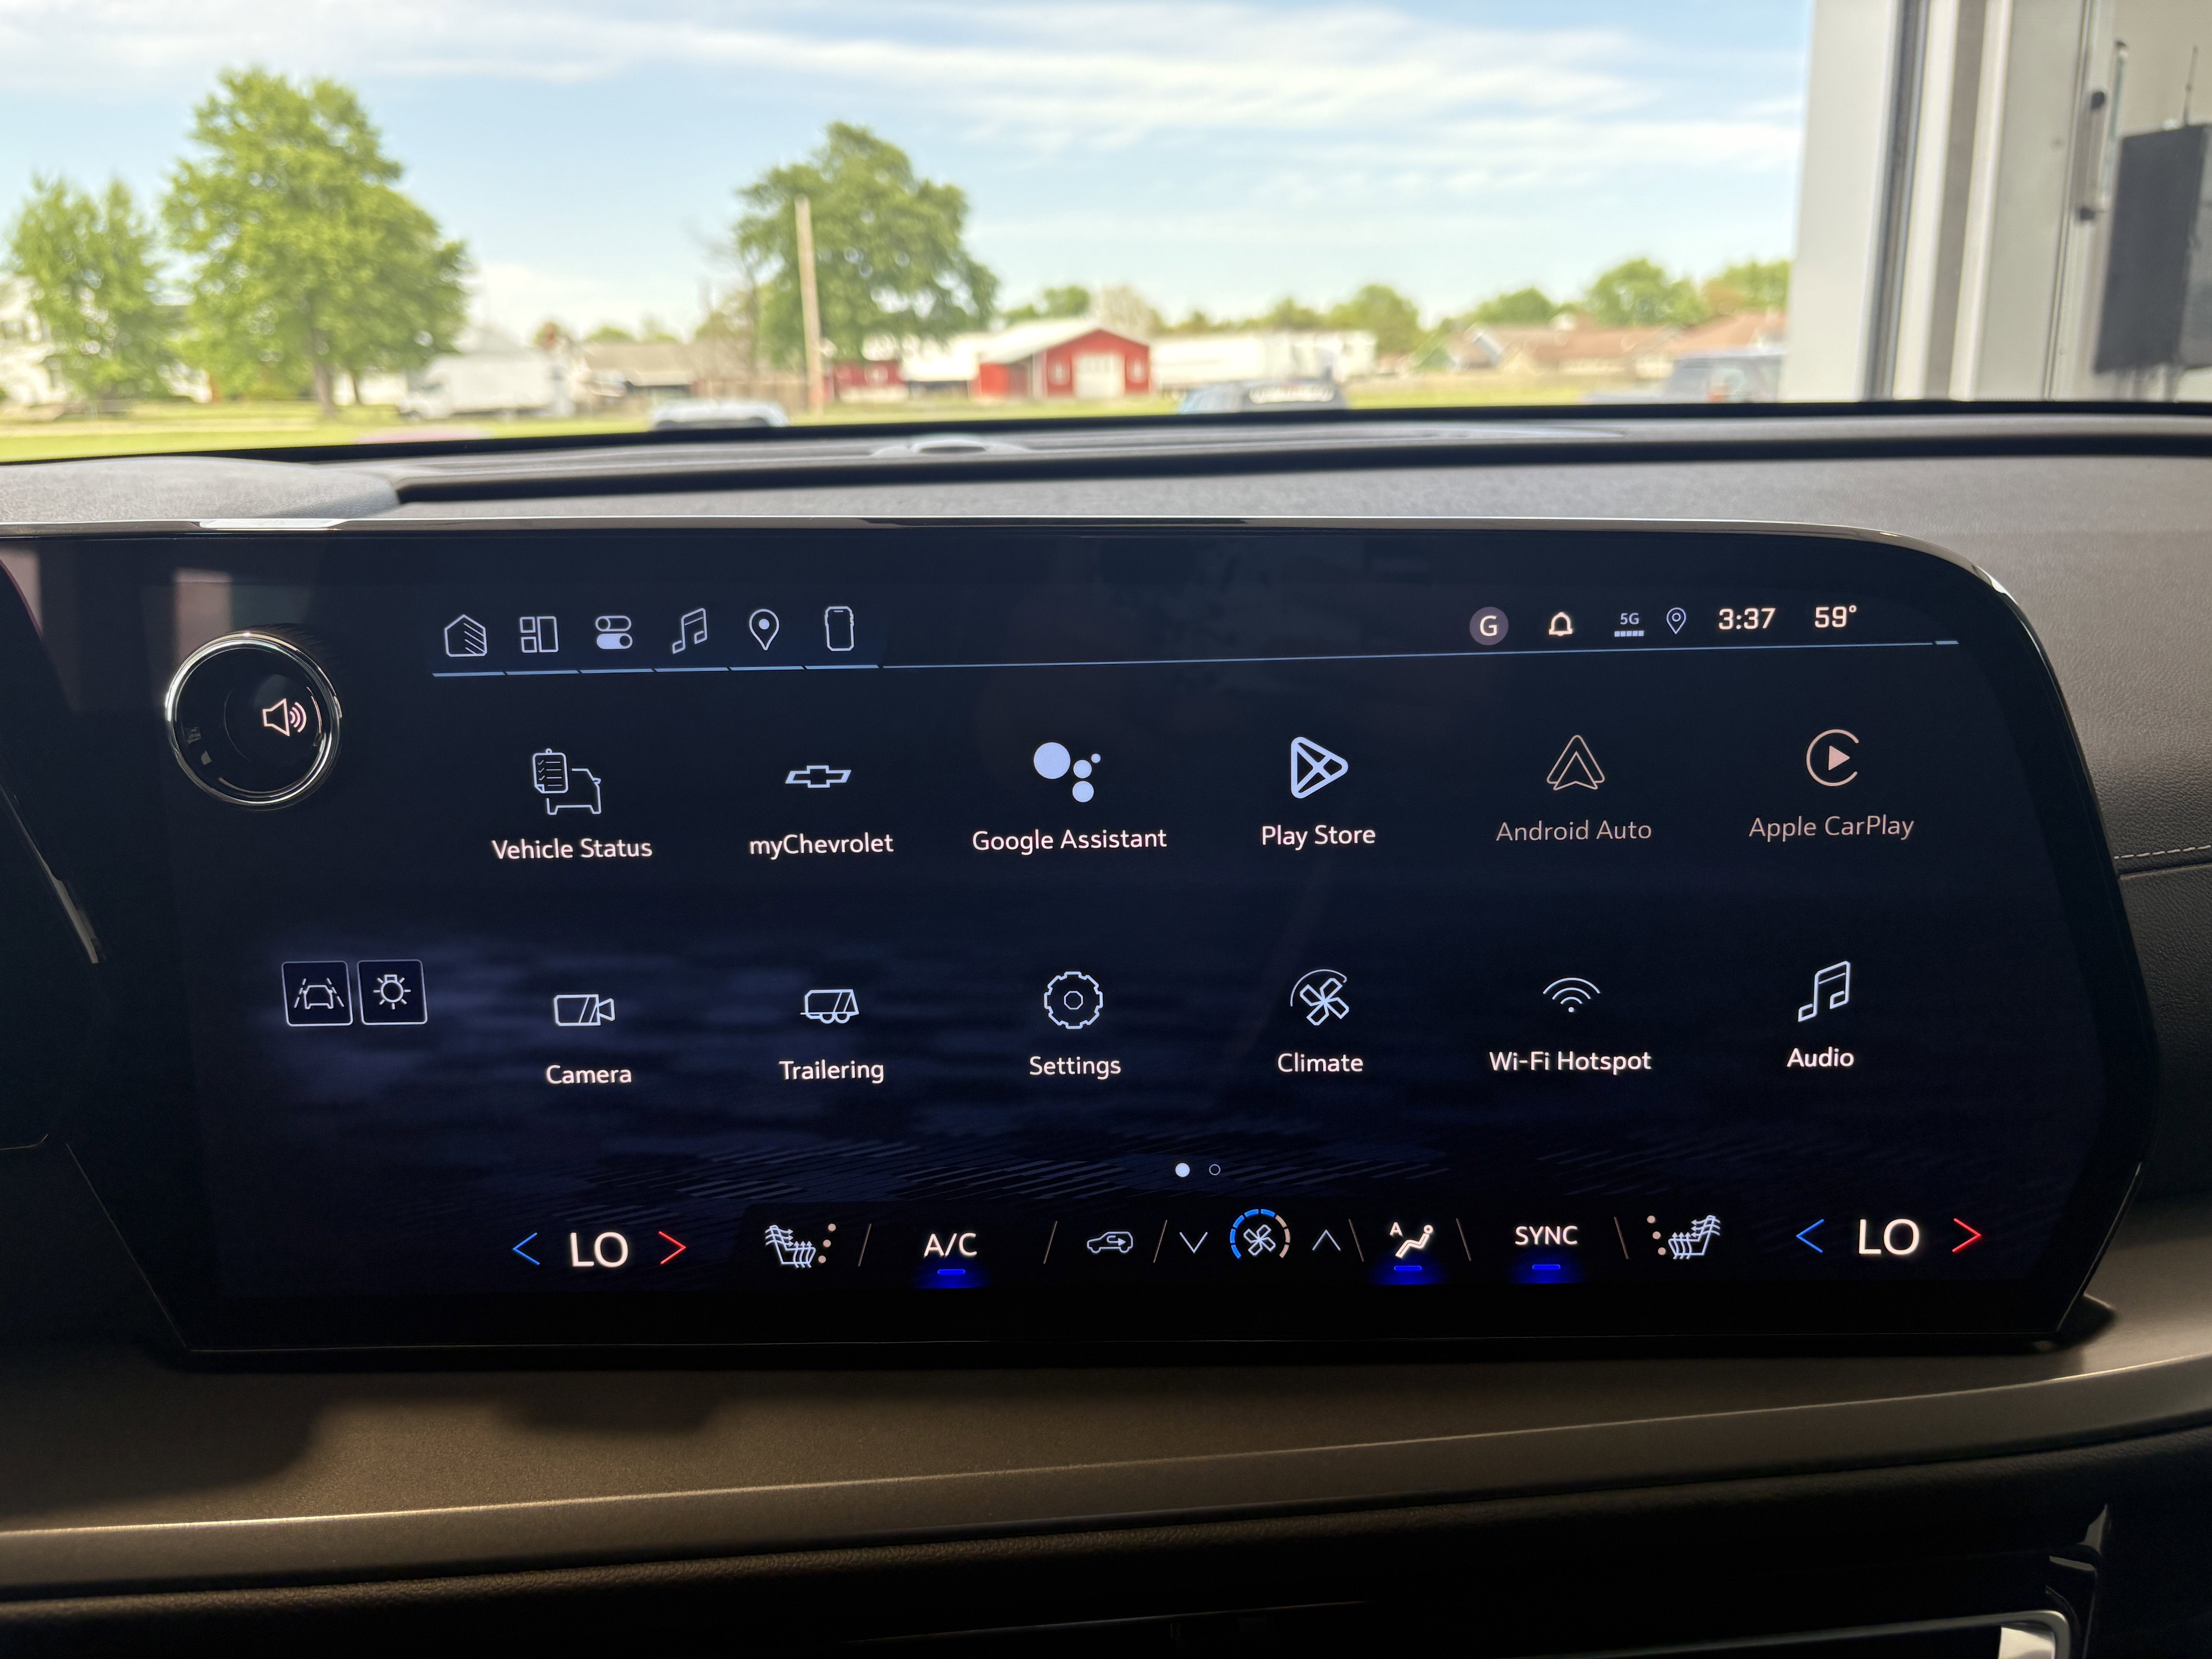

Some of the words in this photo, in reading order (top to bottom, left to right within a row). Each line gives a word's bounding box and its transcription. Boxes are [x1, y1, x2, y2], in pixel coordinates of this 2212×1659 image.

[1480, 615, 1498, 637] G
[1620, 612, 1639, 625] 5G
[1719, 608, 1776, 630] 3:37
[1815, 605, 1857, 628] 59°
[1262, 824, 1308, 851] Play
[1314, 824, 1376, 845] Store
[1496, 819, 1589, 841] Android
[1596, 820, 1652, 839] Auto
[1748, 816, 1816, 842] Apple
[1825, 814, 1914, 840] CarPlay
[491, 838, 574, 859] Vehicle
[580, 838, 653, 858] Status
[750, 832, 894, 860] myChevrolet
[972, 829, 1054, 855] Google
[1060, 829, 1167, 849] Assistant
[1030, 1056, 1121, 1080] Settings
[1278, 1052, 1363, 1072] Climate
[1489, 1051, 1549, 1071] Wi-Fi
[1558, 1051, 1651, 1075] Hotspot
[1786, 1046, 1854, 1067] Audio
[546, 1065, 632, 1084] Camera
[779, 1059, 884, 1084] Trailering
[1389, 1222, 1403, 1237] A
[1515, 1225, 1578, 1245] SYNC
[1858, 1219, 1920, 1256] LO
[570, 1232, 628, 1267] LO
[924, 1233, 977, 1257] A/C
